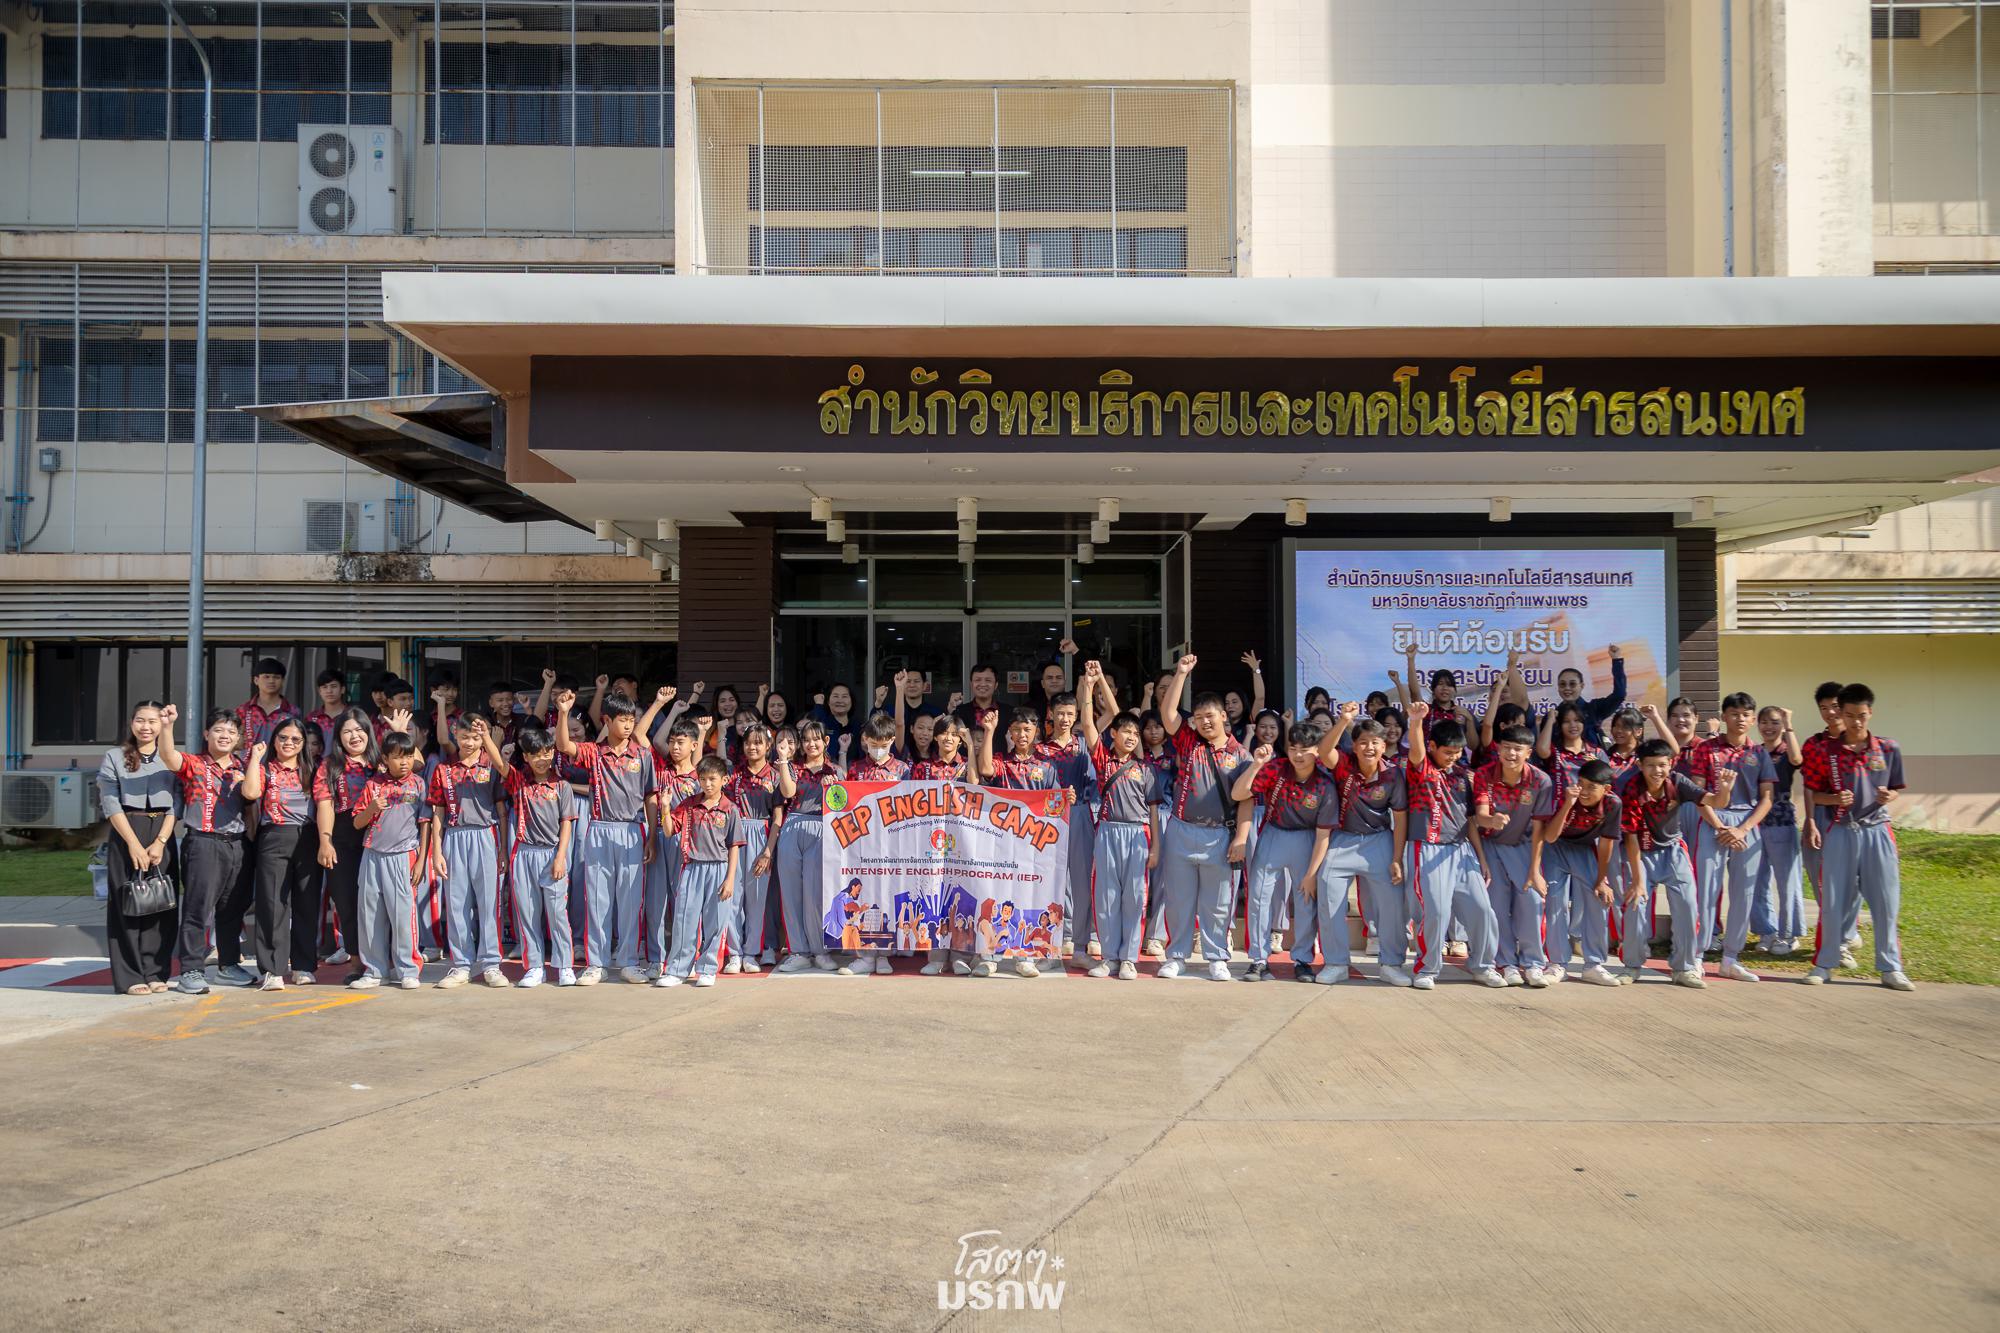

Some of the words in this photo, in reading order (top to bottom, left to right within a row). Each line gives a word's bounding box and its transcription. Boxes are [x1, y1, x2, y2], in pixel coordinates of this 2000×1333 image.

[817, 364, 1805, 437] สำนักวิทยบริการและเทคโนโลยีสารสนเทศ
[1327, 567, 1633, 586] สำนักวิทยบริการและเทคโนโลยีสารสนเทศ
[1372, 592, 1588, 611] มหาวิทยาลัยราชภัฏกำแพงเพชร
[1392, 620, 1570, 654] ยินดีต้อนรับ
[204, 792, 214, 821] English
[1432, 800, 1442, 830] English
[959, 820, 985, 832] Municipal
[986, 827, 1003, 839] School
[989, 802, 1060, 852] CAMP
[841, 867, 902, 876] INTENSIVE
[906, 867, 953, 876] ENGLISH
[954, 868, 1014, 881] PROGRAM
[1017, 873, 1043, 883] (IEP)
